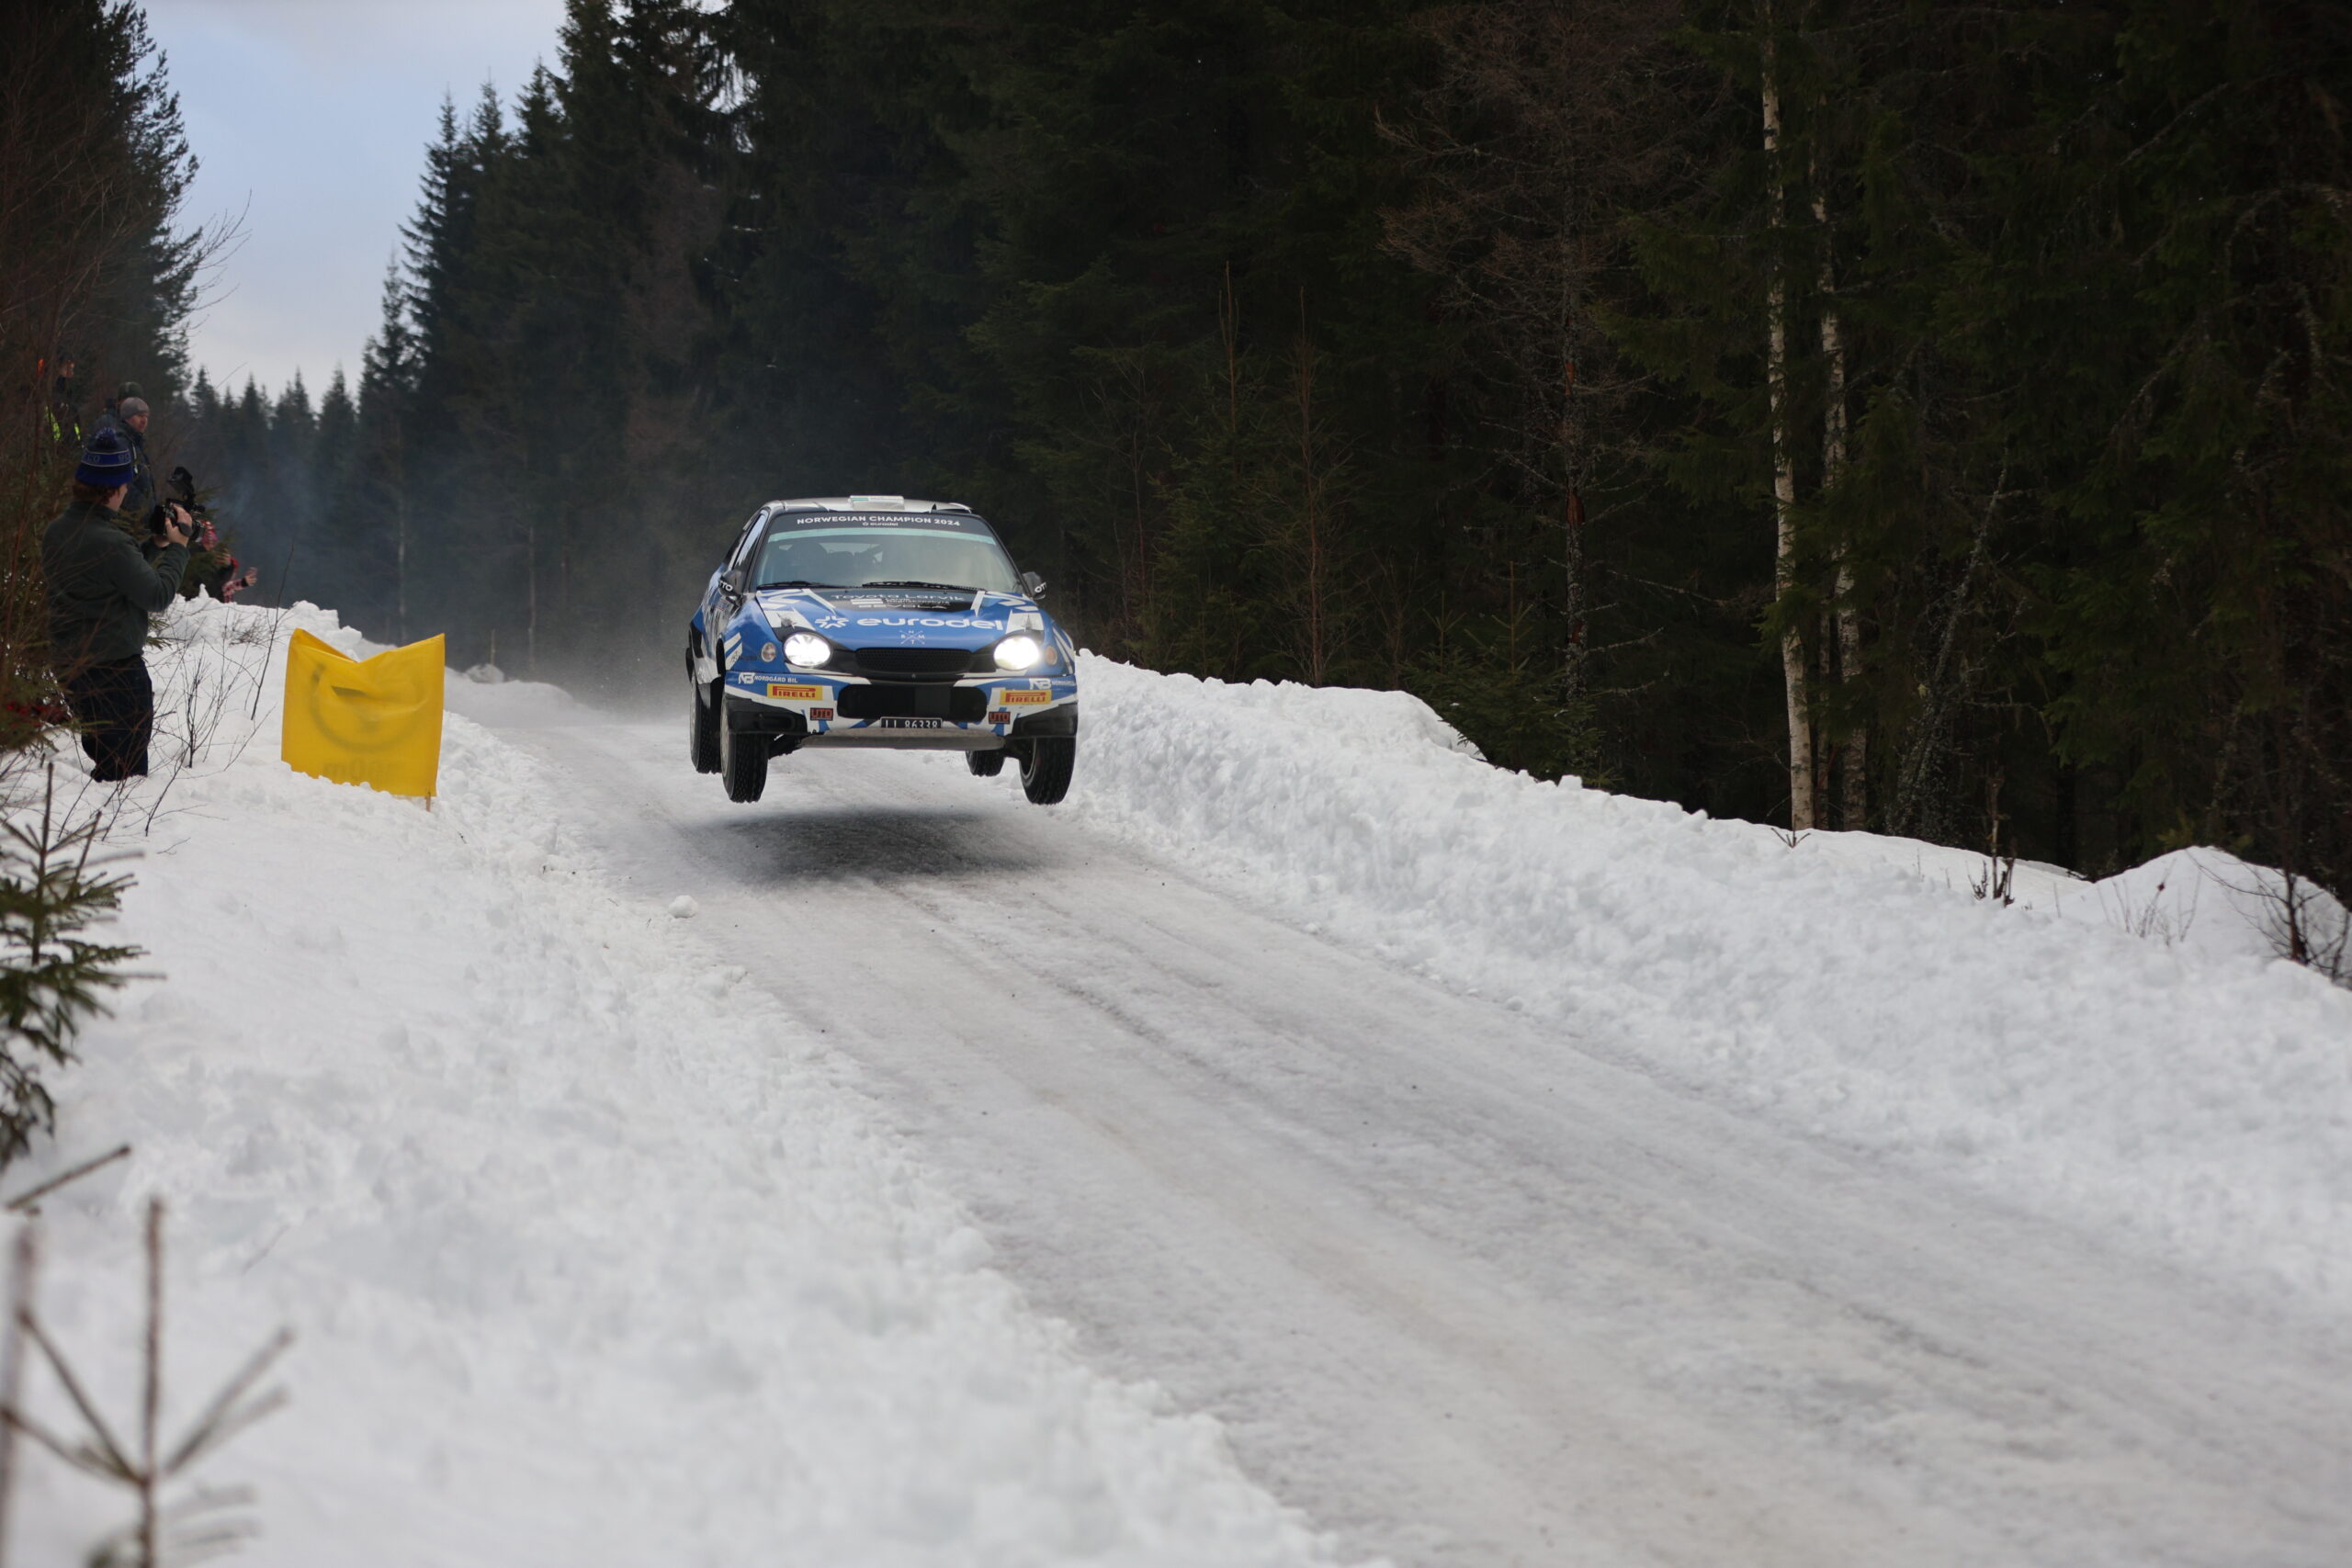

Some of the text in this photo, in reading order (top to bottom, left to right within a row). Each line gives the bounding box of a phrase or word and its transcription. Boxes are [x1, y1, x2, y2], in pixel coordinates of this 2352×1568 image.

[797, 515, 866, 525] NORWEGIAN
[869, 515, 932, 524] CHAMPION
[904, 593, 965, 602] Larvik
[856, 617, 1004, 631] eurodel
[772, 685, 817, 698] PIRELLI
[1005, 691, 1046, 703] PIRELLI
